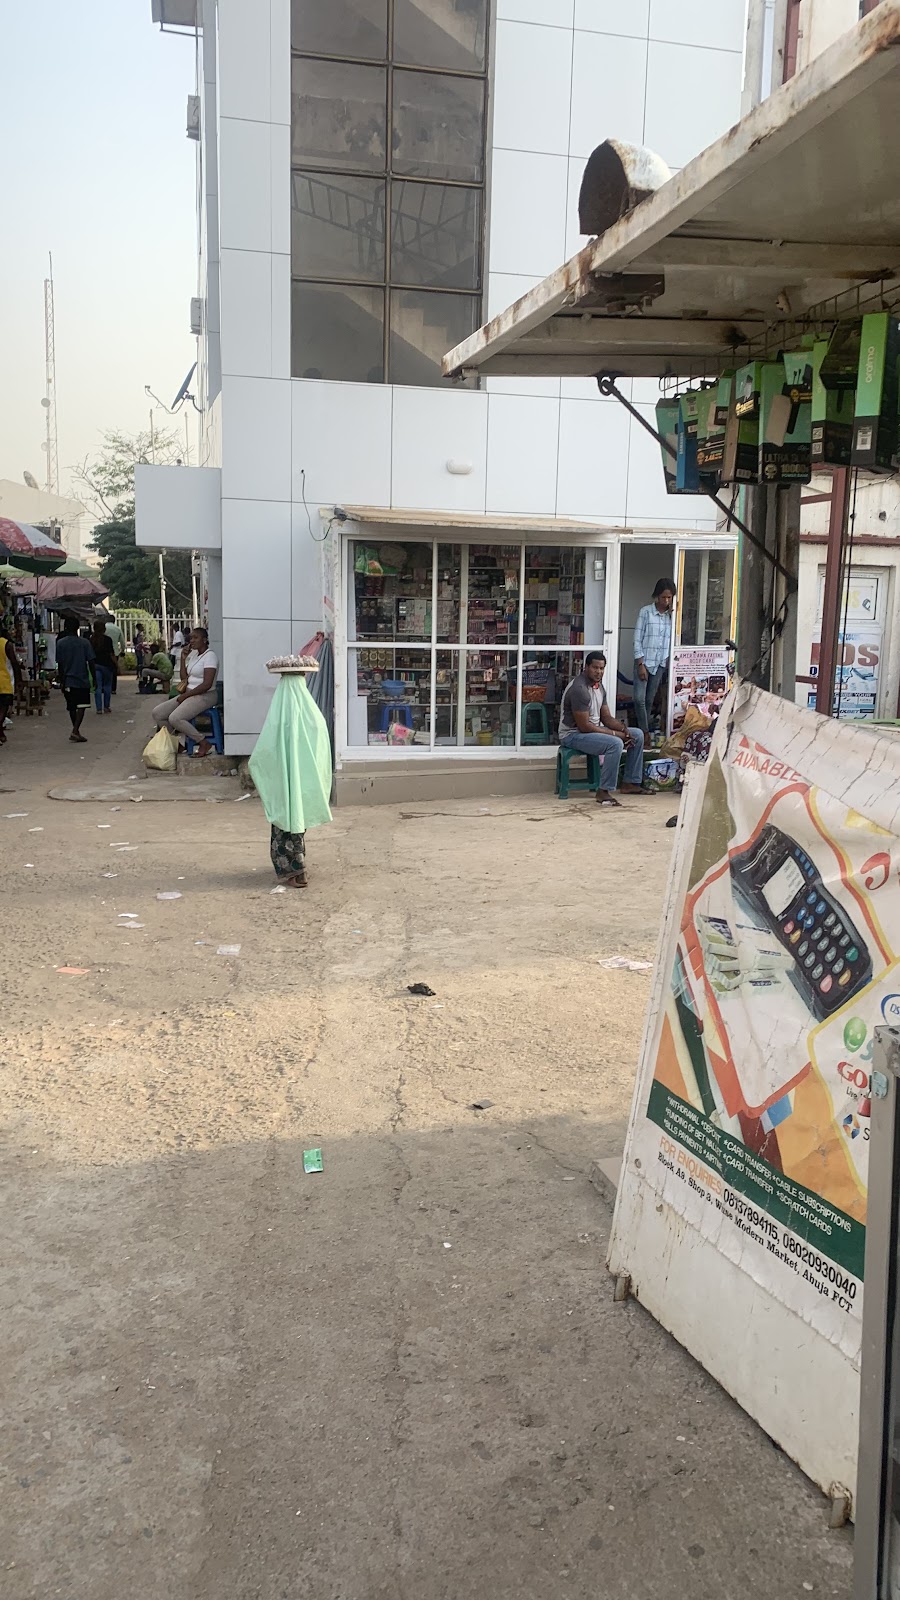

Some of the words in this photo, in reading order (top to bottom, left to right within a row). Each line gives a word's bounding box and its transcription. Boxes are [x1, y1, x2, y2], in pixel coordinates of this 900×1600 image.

[865, 346, 876, 383] oraimo
[764, 454, 788, 462] ULTRA
[666, 1108, 688, 1128] FUNDING
[688, 1124, 695, 1134] OF
[694, 1129, 705, 1142] BET
[725, 1154, 744, 1172] CARD
[745, 1166, 774, 1195] TRANSFER
[779, 1192, 810, 1219] SCRATCH
[808, 1211, 832, 1236] CARDS
[678, 1130, 702, 1154] PAYMENTS
[726, 1142, 745, 1160] CARD
[775, 1176, 798, 1198] CABLE
[798, 1191, 852, 1232] SUBSCRIPTIONS
[658, 1152, 674, 1172] Block
[688, 1176, 706, 1198] Shop
[716, 1199, 734, 1221] Wuse
[734, 1216, 764, 1246] Modern
[766, 1241, 800, 1275] Market,
[802, 1269, 829, 1297] Abuja
[831, 1290, 853, 1314] FCT
[660, 1136, 676, 1159] FOR
[782, 1232, 857, 1300] 08020930040
